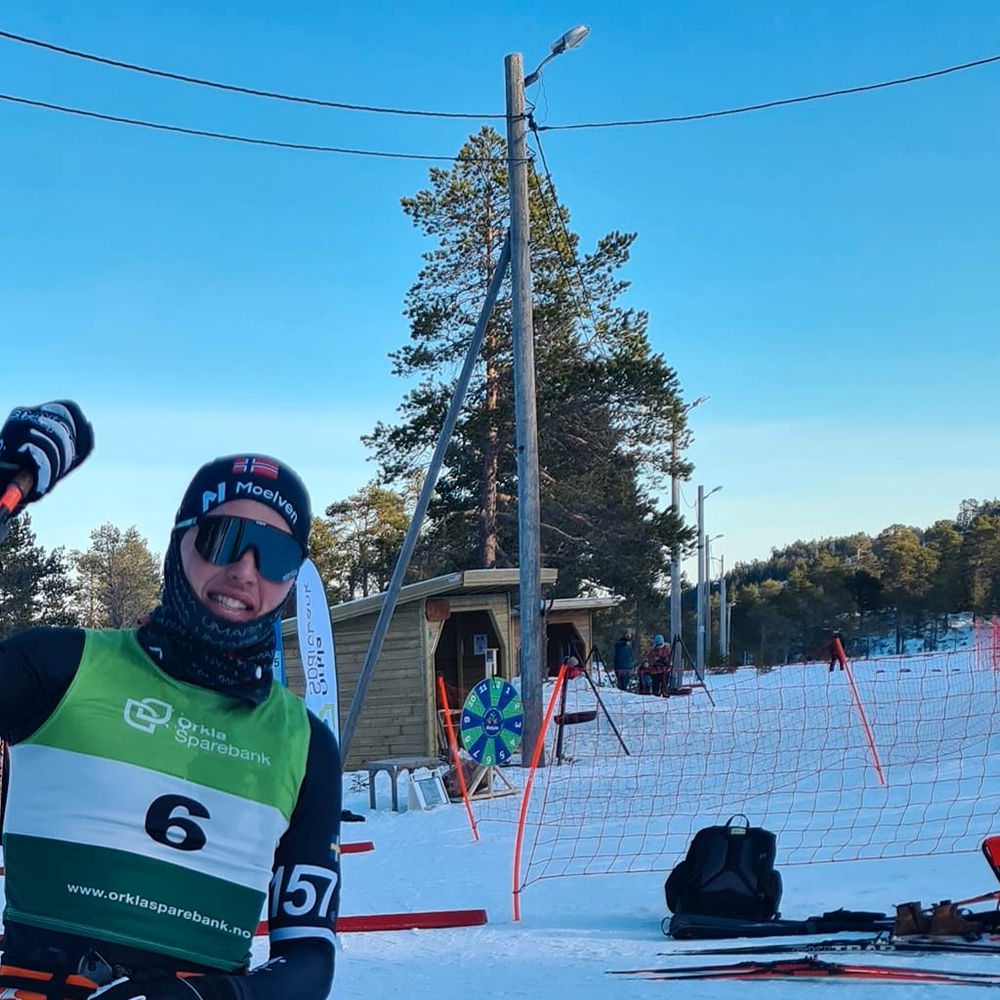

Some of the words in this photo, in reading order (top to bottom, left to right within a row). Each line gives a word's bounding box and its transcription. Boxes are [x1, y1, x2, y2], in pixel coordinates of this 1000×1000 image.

[235, 481, 298, 524] Moelven
[174, 730, 272, 766] Sparebank
[177, 714, 227, 741] Orkla
[144, 793, 211, 852] 6
[66, 883, 252, 939] www.orklasparebank.no
[269, 864, 338, 918] 157
